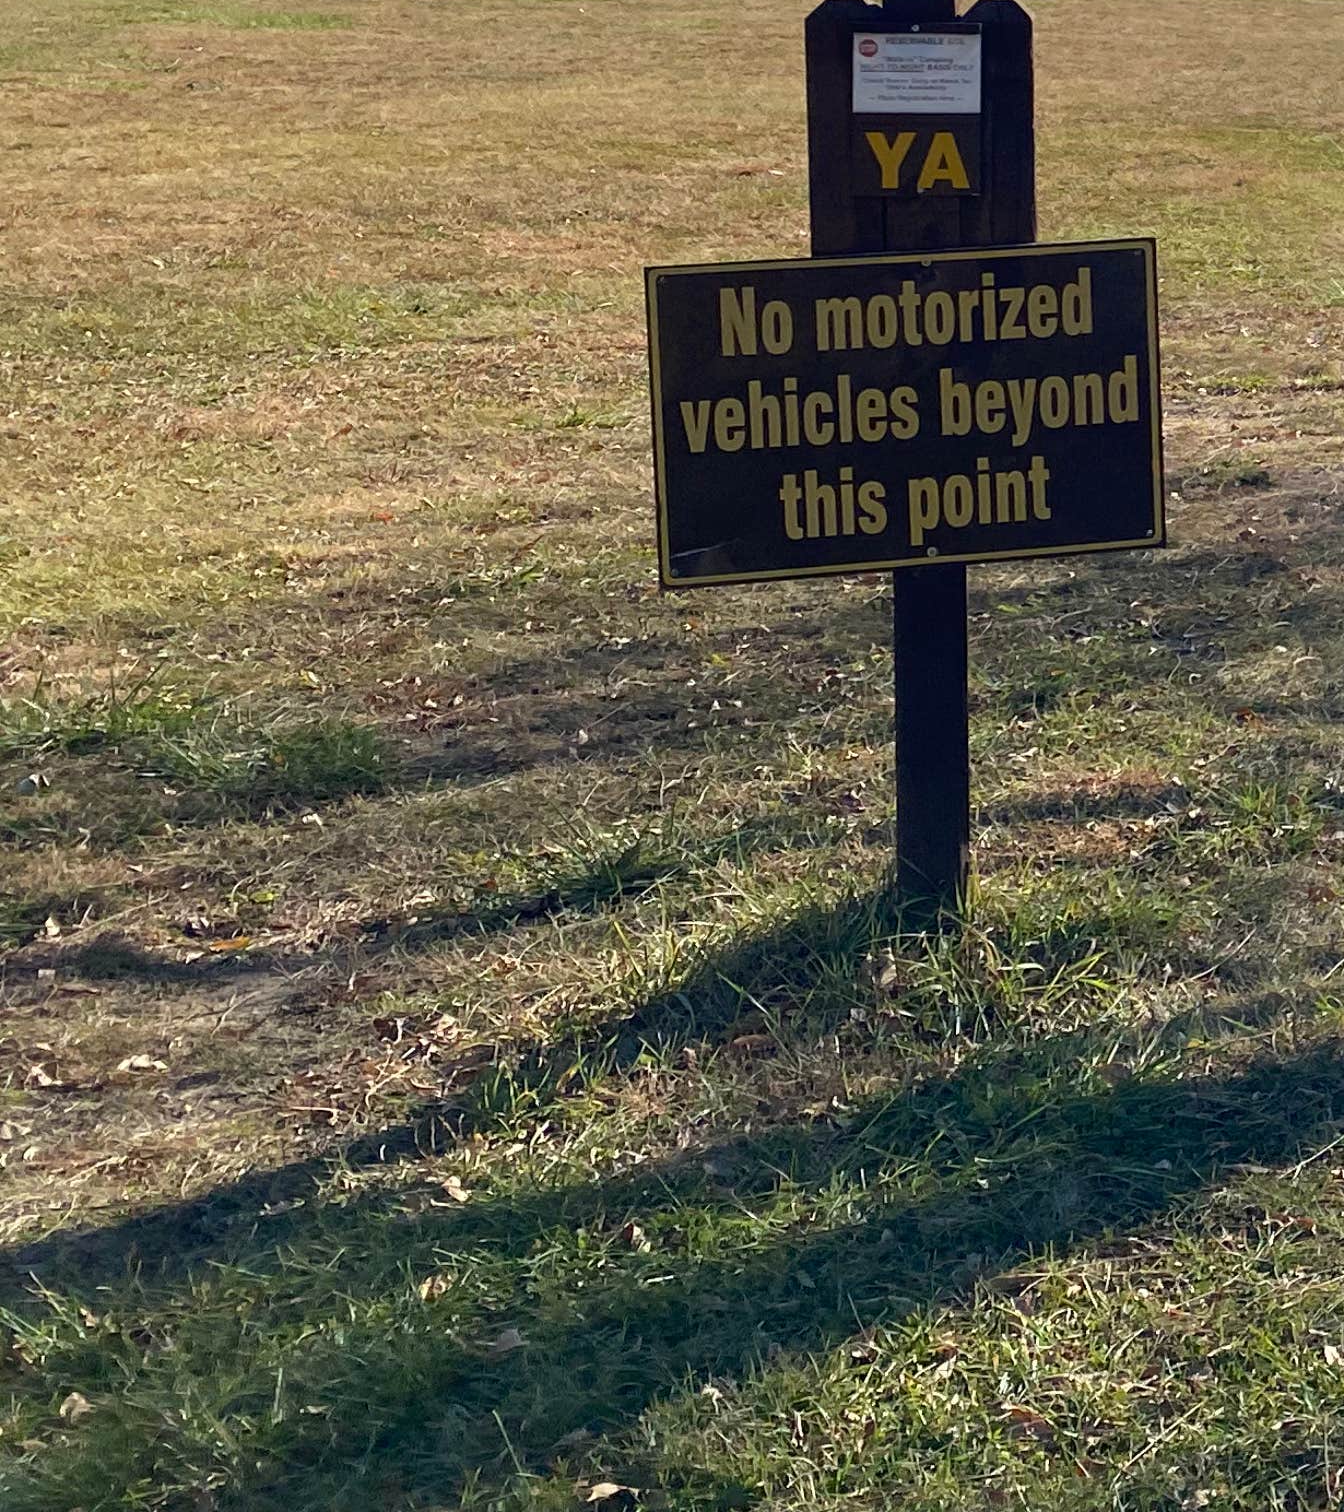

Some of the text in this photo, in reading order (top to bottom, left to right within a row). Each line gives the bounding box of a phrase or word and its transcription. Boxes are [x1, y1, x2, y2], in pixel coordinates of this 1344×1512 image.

[865, 132, 970, 189] YA
[720, 267, 1093, 356] No motorized
[680, 356, 1139, 452] vehicles beyond
[780, 456, 1051, 545] this point
